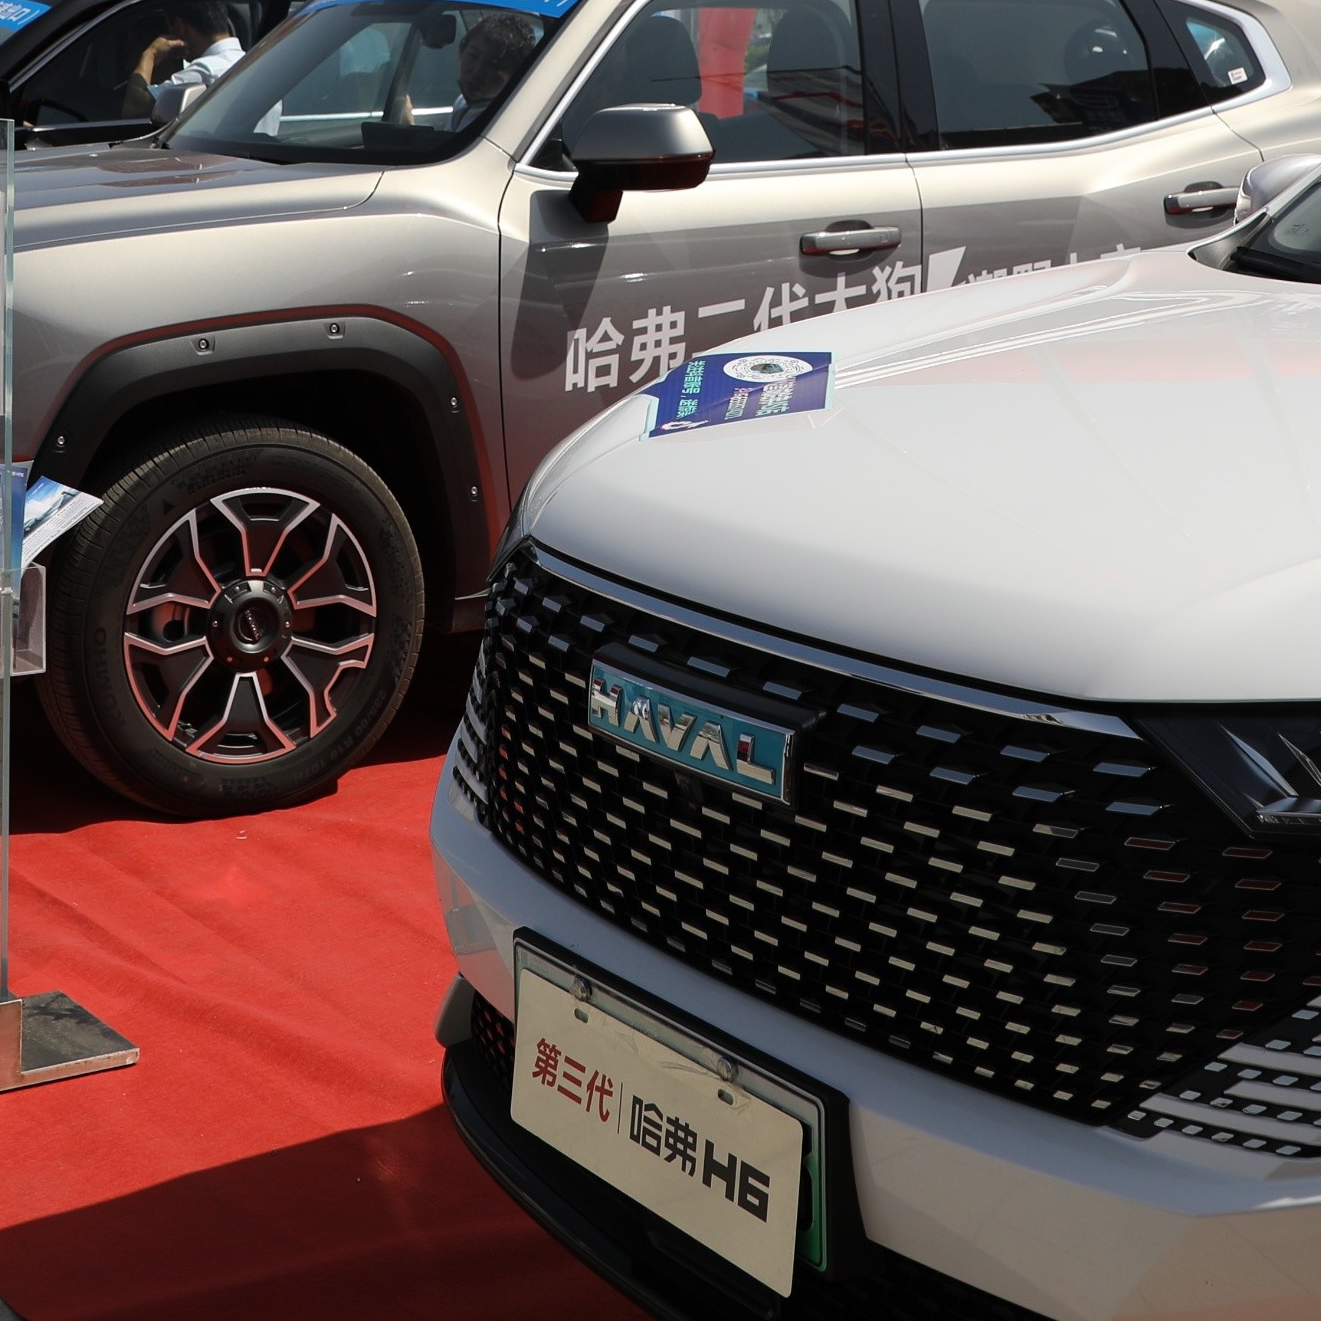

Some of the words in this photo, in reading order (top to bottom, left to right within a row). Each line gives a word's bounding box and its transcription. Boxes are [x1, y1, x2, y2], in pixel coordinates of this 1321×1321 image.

[591, 678, 775, 785] HAVAL
[532, 1037, 614, 1122] 第三代
[629, 1094, 771, 1223] 哈弗H6
